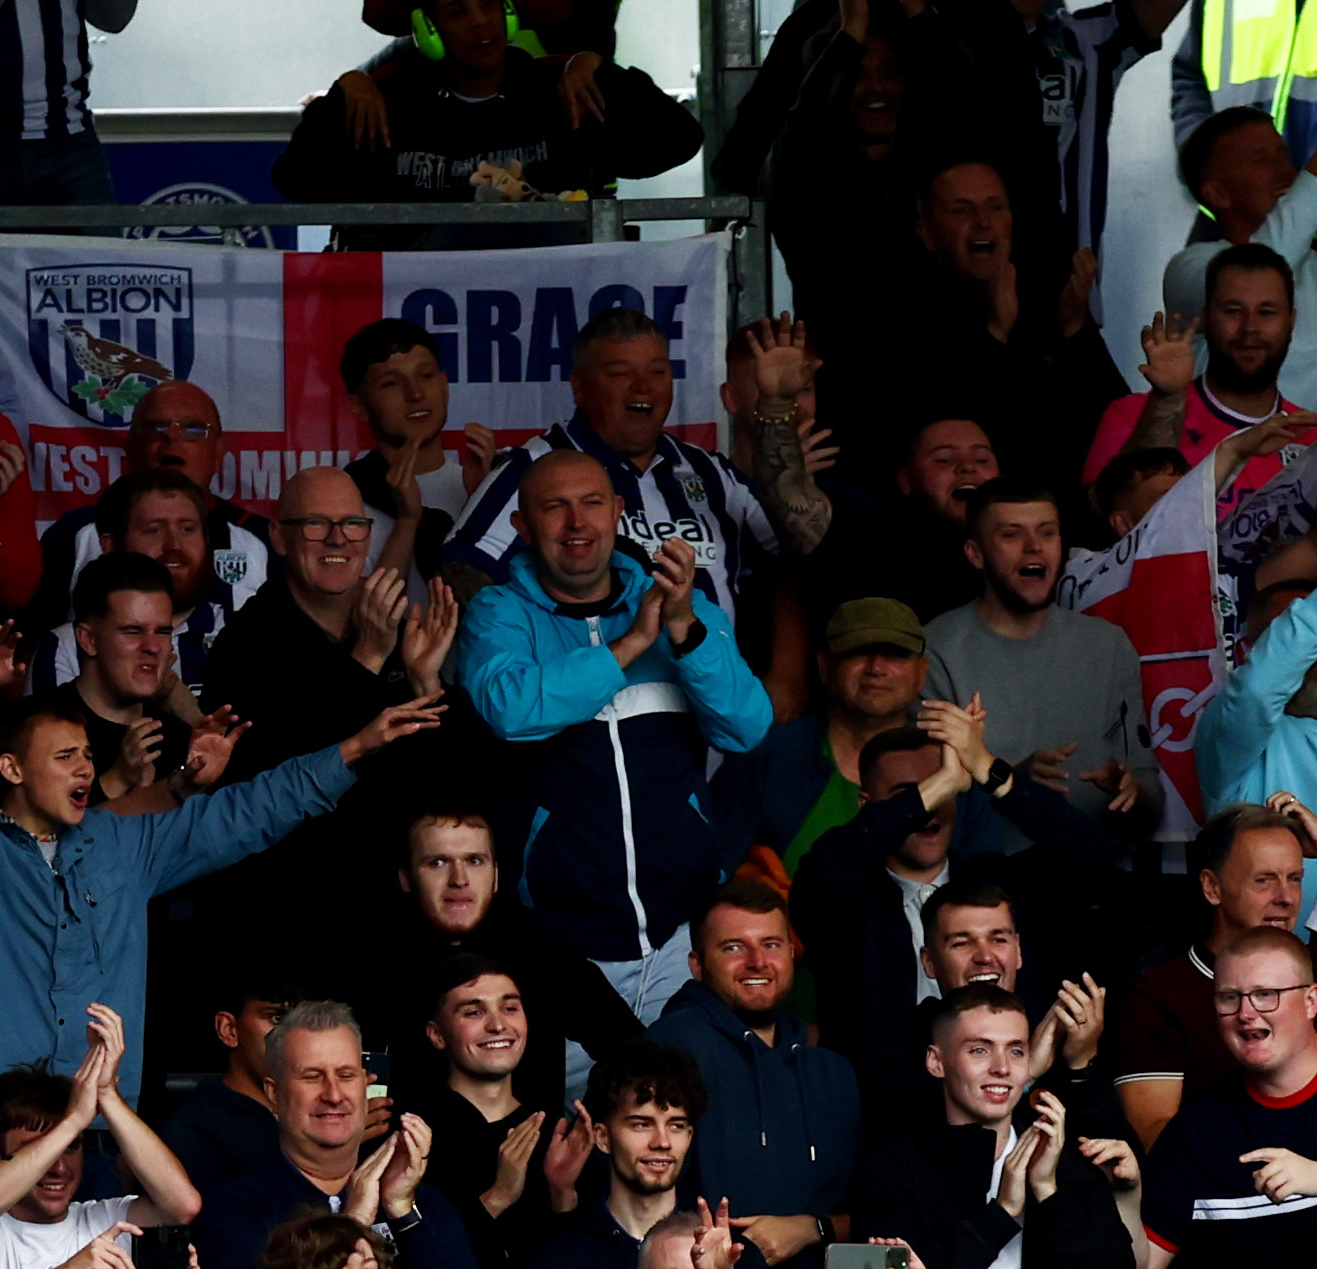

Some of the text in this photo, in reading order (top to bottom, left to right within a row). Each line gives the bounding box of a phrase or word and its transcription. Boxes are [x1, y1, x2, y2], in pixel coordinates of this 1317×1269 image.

[34, 273, 182, 287] WEST BROMWICH
[34, 287, 183, 315] ALBION
[620, 512, 714, 544] ideal
